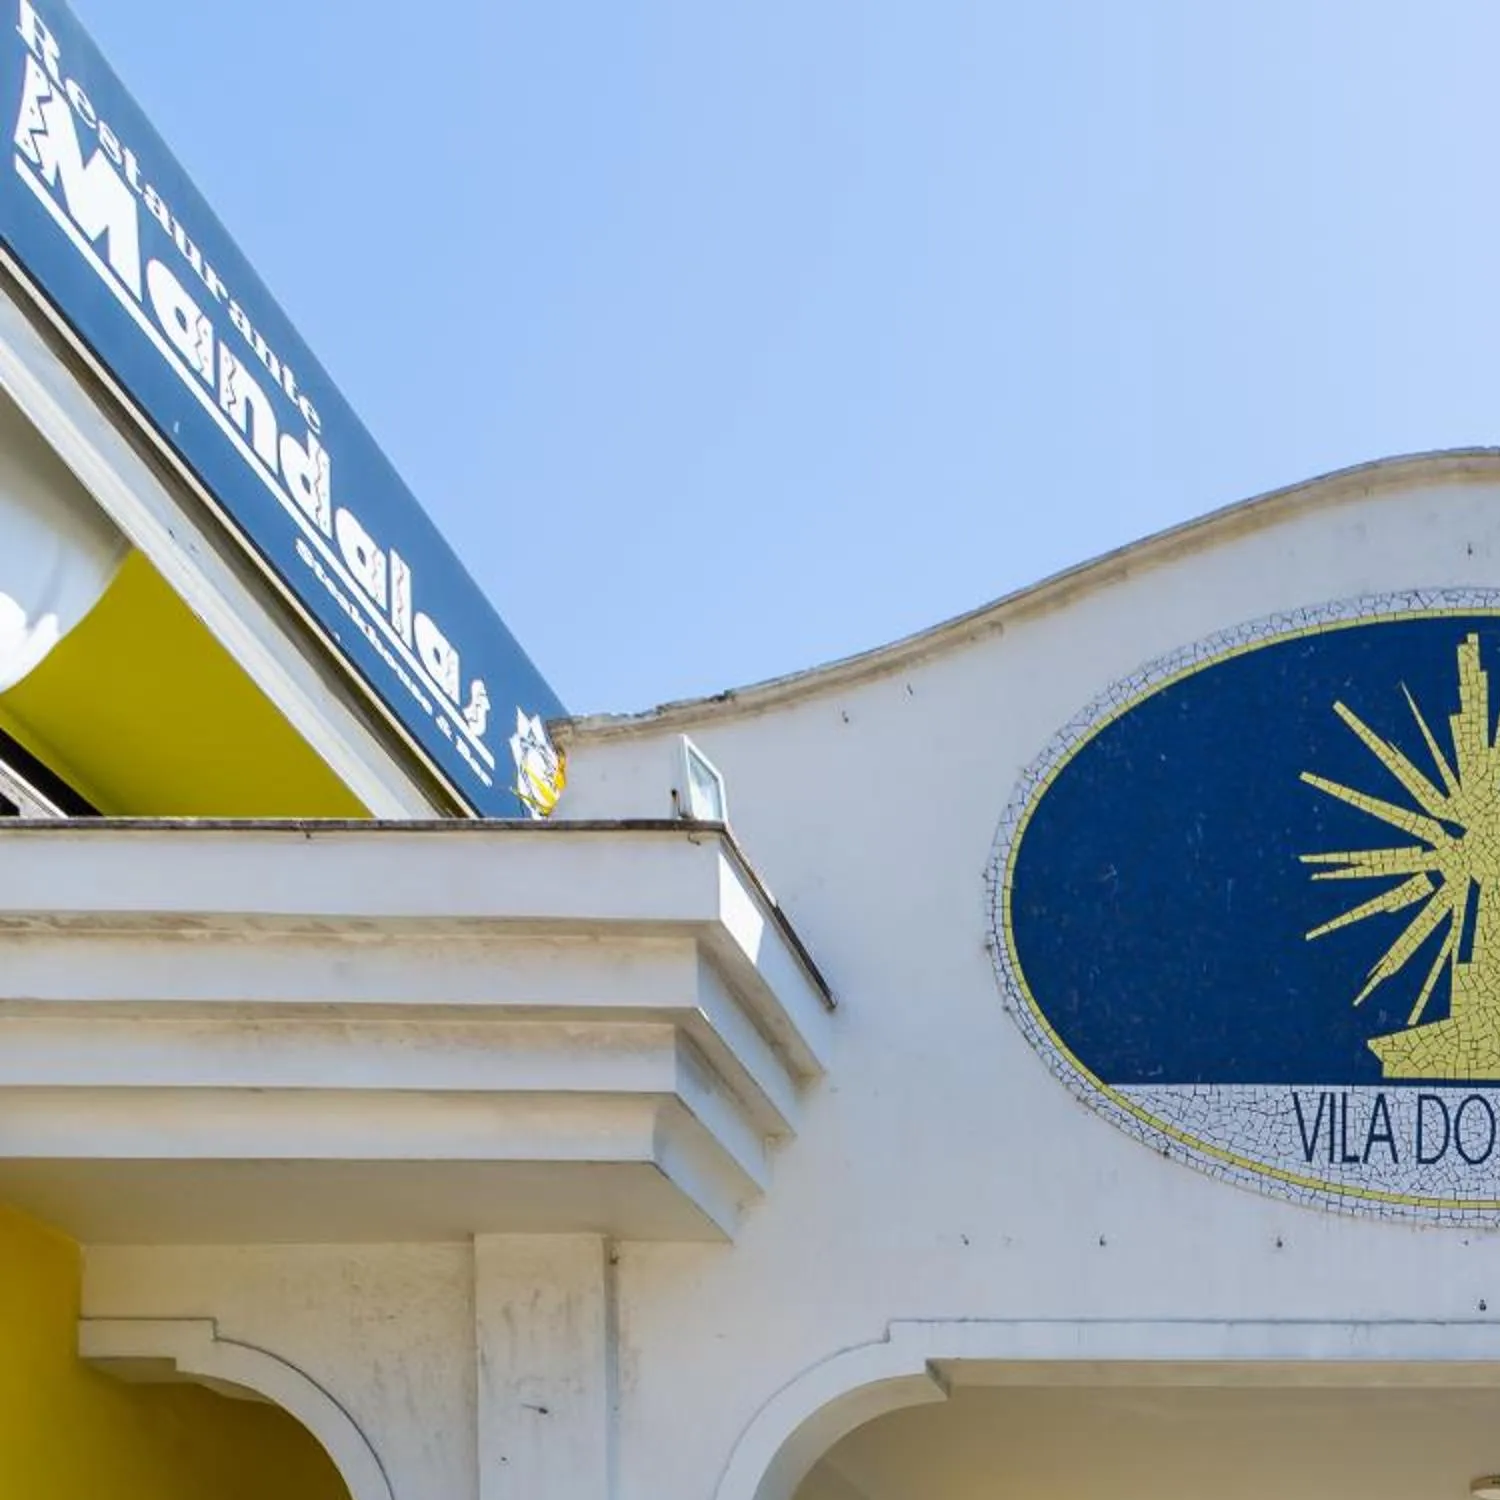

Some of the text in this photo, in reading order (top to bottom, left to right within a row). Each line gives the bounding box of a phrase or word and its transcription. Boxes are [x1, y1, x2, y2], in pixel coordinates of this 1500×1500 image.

[14, 54, 489, 735] Mandalas
[16, 0, 321, 434] Restaurante
[1293, 1091, 1399, 1164] VILA
[1416, 1093, 1497, 1165] DO
